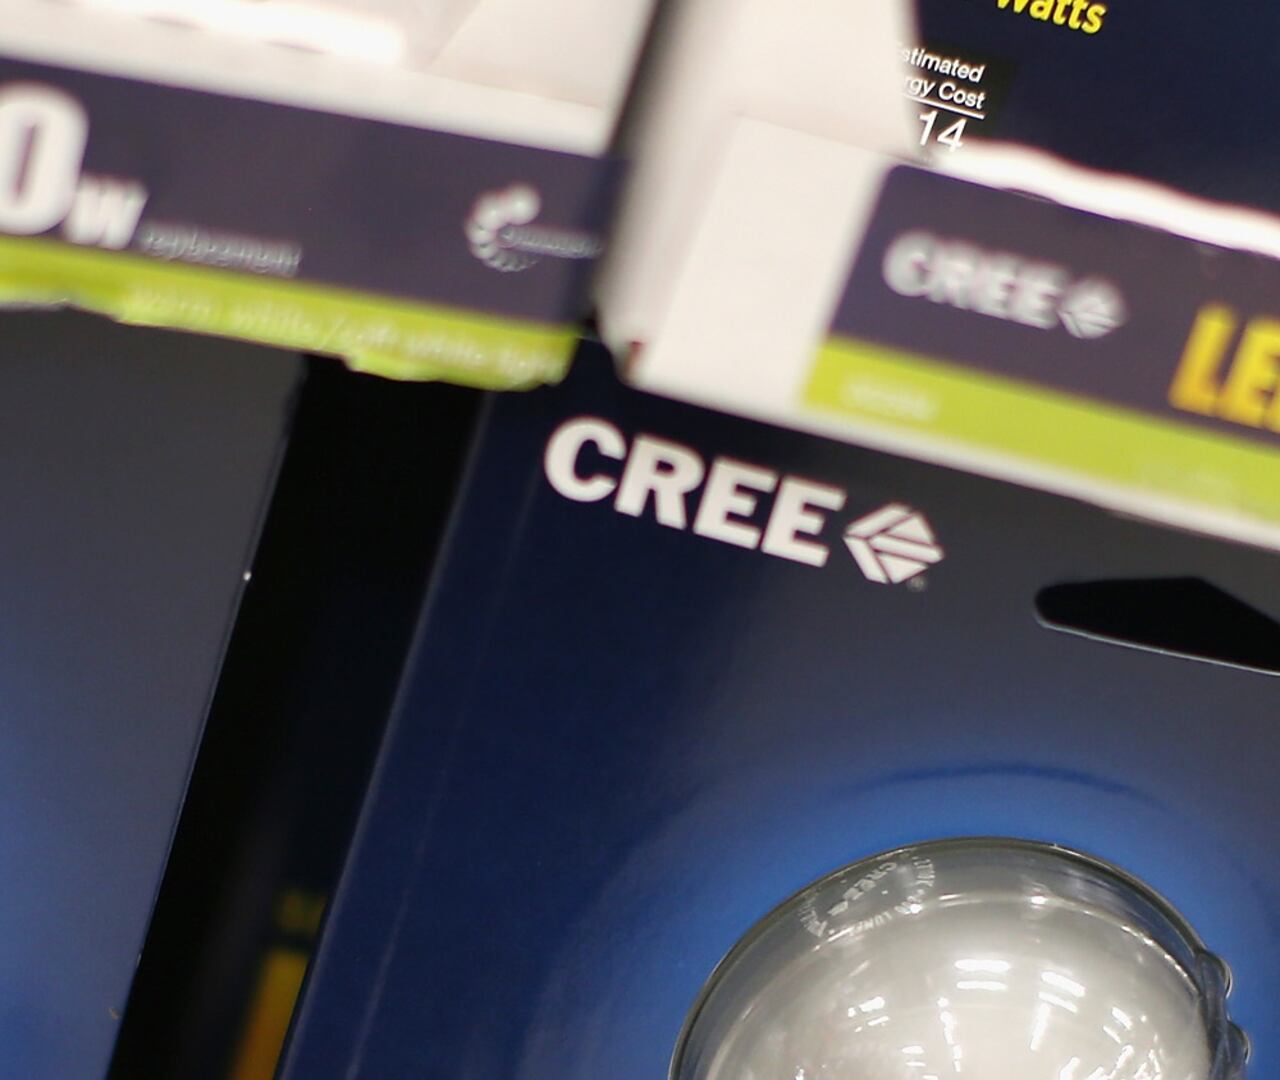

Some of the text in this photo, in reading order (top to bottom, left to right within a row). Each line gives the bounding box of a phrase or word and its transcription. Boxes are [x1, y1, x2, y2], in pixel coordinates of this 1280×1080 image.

[996, 0, 1107, 34] atts
[902, 48, 985, 83] stimated
[938, 81, 986, 110] Cost
[883, 229, 1063, 332] CREE
[544, 416, 847, 567] CREE
